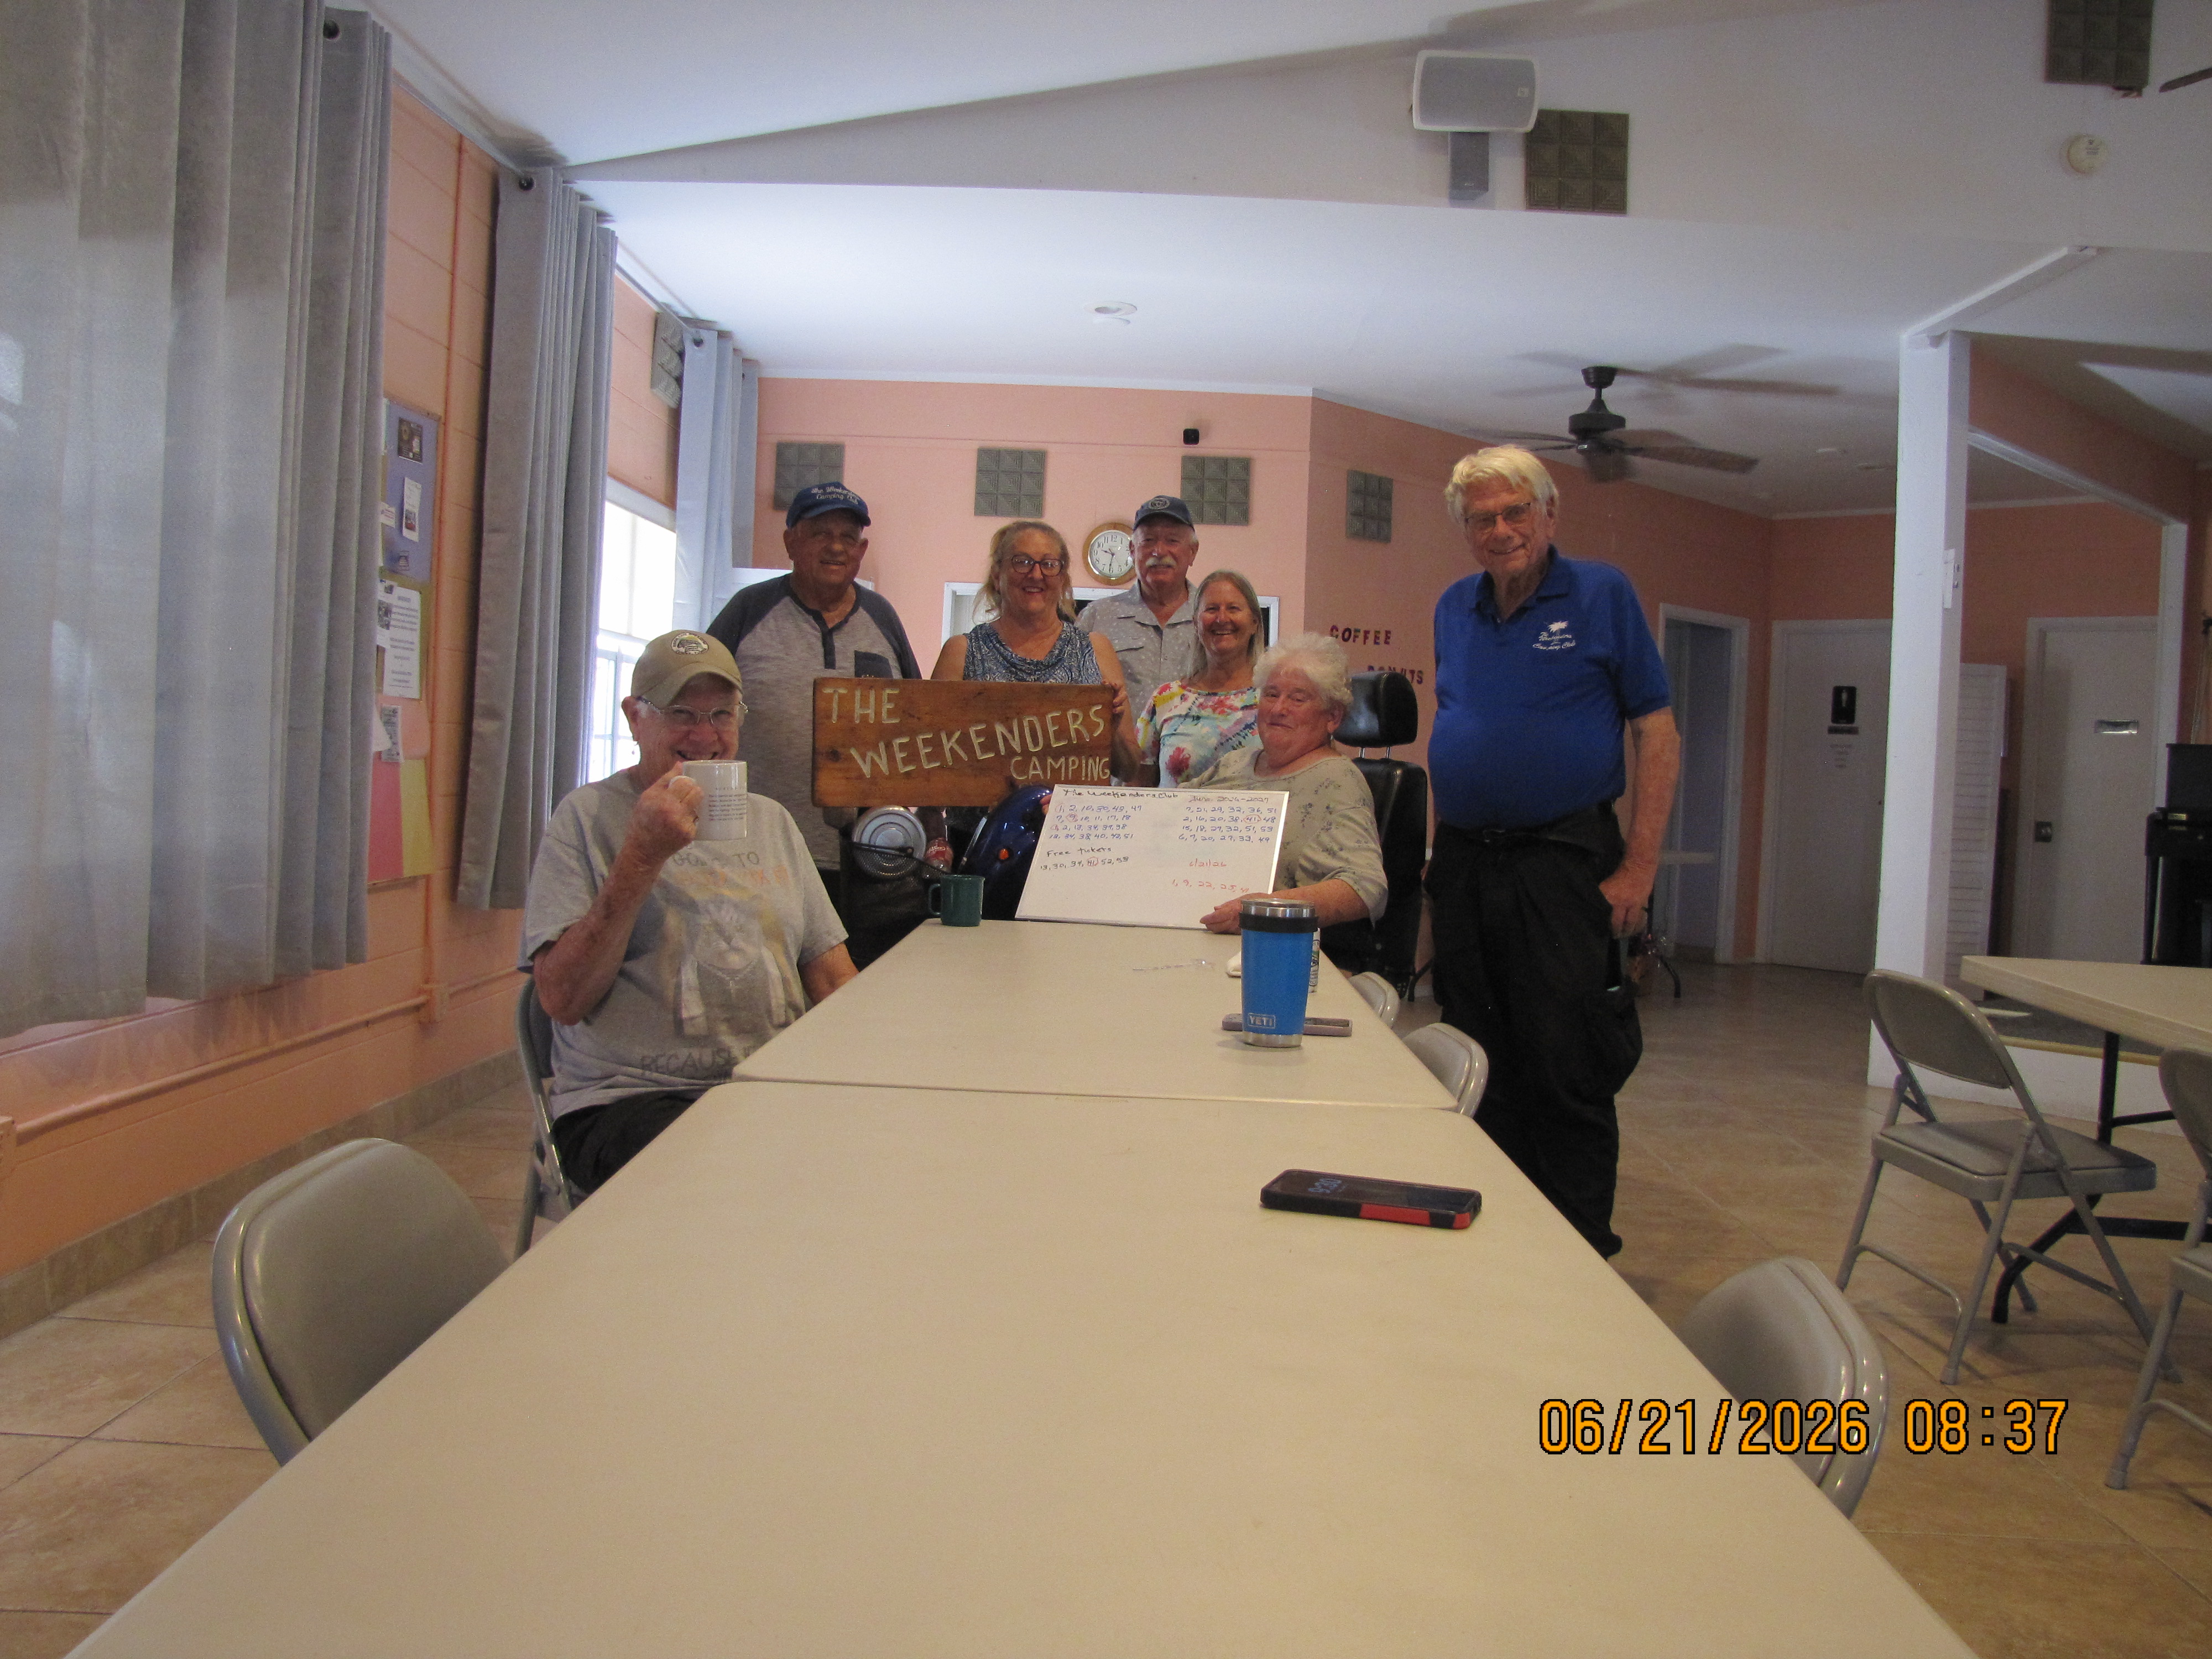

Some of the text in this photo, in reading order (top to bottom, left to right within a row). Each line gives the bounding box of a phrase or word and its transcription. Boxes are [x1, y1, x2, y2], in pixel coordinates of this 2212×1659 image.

[1111, 534, 1117, 542] 12
[1330, 625, 1391, 645] COFFEE
[822, 688, 901, 723] THE
[849, 703, 1105, 778] WEEKENDERS
[1010, 755, 1110, 781] CAMPING
[1245, 825, 1256, 833] 51,
[732, 851, 760, 867] TO
[1198, 881, 1215, 890] 22,
[1249, 1014, 1274, 1027] YETI
